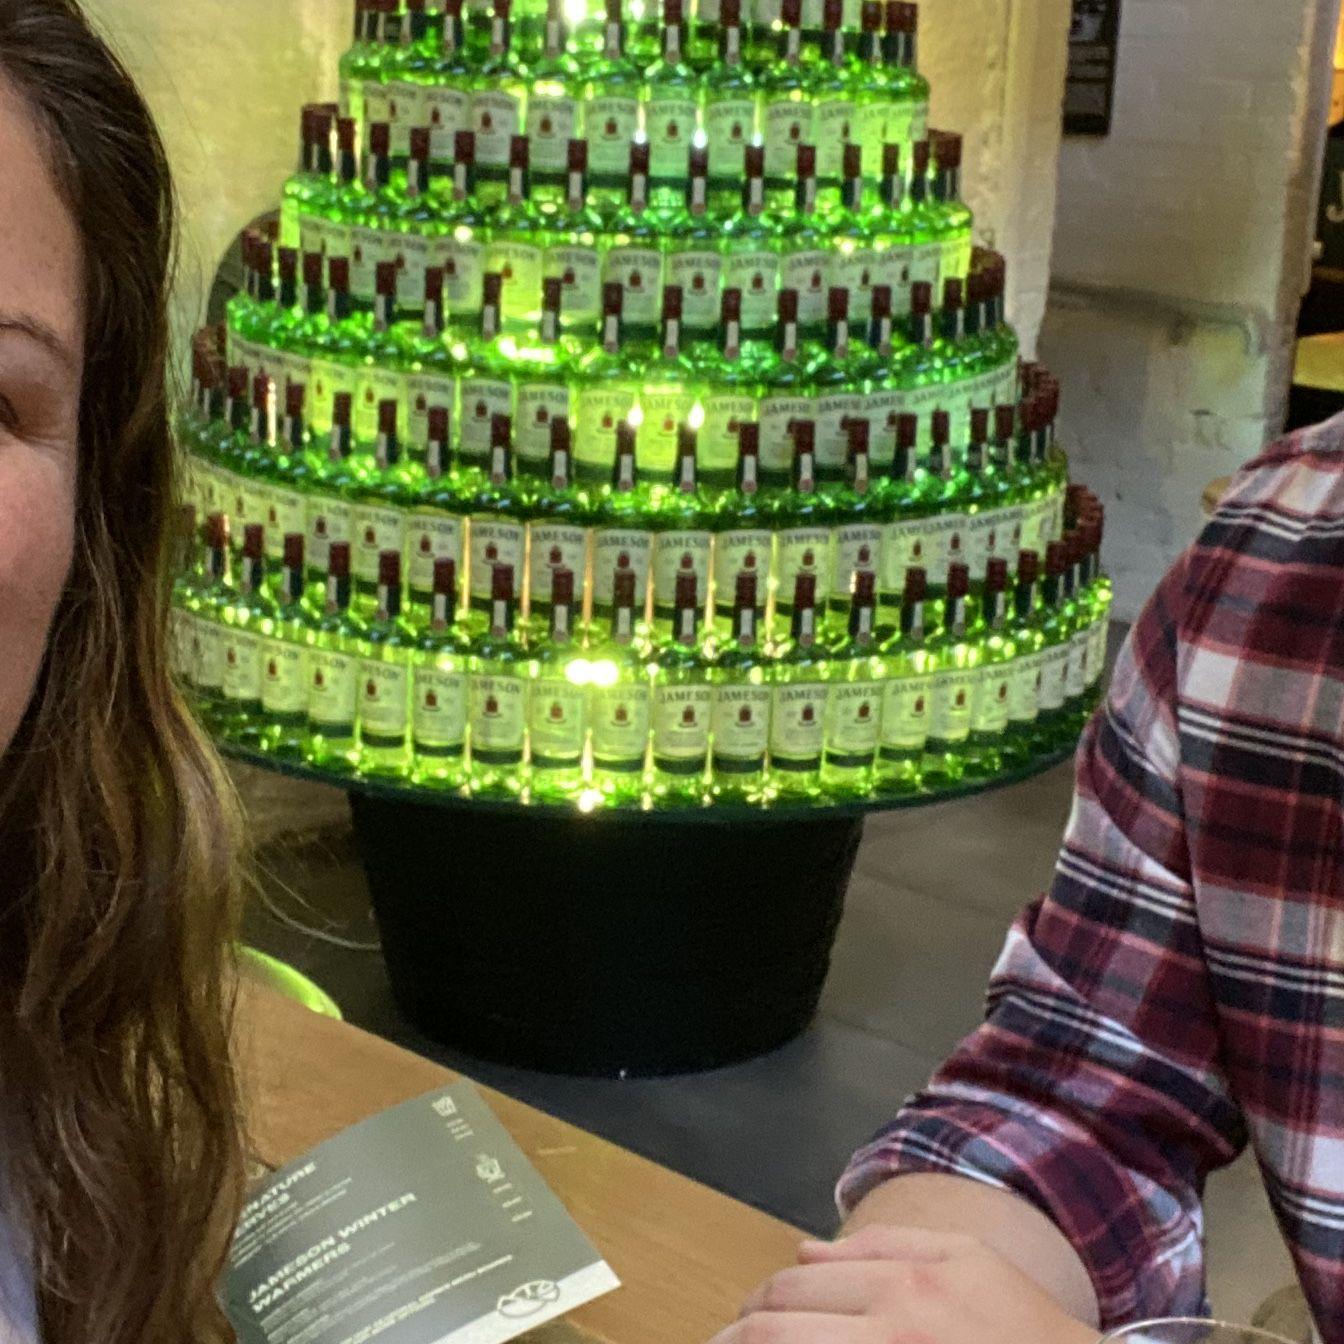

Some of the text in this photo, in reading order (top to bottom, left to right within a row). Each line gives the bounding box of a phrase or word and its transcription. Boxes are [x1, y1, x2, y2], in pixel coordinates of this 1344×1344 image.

[249, 1235, 337, 1304] JAMESON
[337, 1192, 417, 1239] WINTER
[252, 1242, 352, 1314] WARMERS
